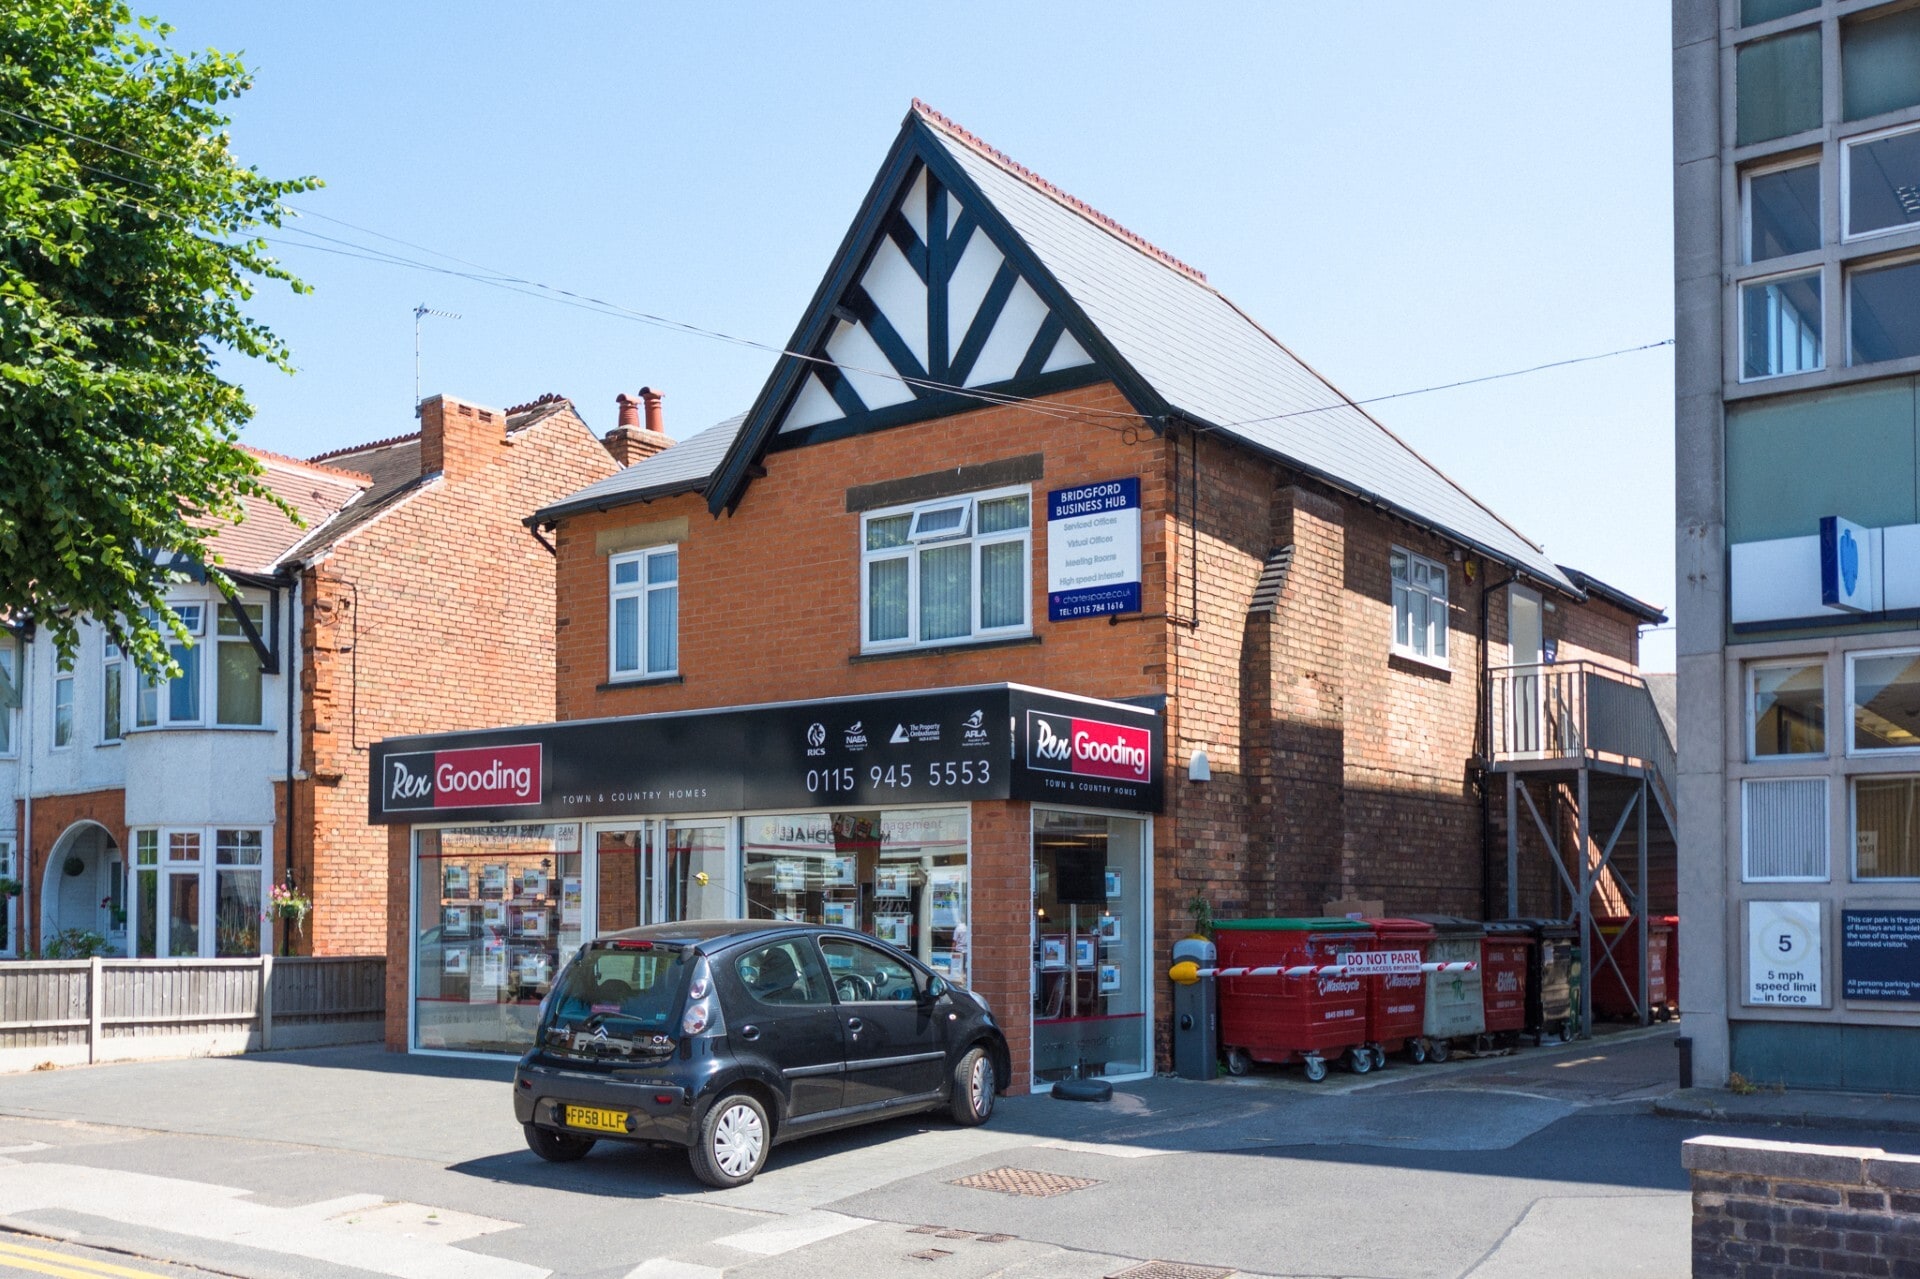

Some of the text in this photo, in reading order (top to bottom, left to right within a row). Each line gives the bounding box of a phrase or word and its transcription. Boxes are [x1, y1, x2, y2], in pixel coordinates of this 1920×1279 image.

[1061, 483, 1121, 503] BRIDGFORD
[1056, 495, 1126, 516] BUSINESS HUB
[1063, 516, 1117, 532] Serviced Offices
[1089, 535, 1113, 546] Offices
[1065, 553, 1117, 568] Meeting Rooms
[1073, 605, 1090, 615] 0115
[845, 735, 867, 744] NAEA
[964, 730, 987, 738] ARLA
[807, 748, 826, 756] RICS
[1036, 719, 1072, 760] Rex
[1074, 731, 1145, 775] Gooding
[391, 759, 531, 799] Rex Gooding
[806, 760, 990, 792] 0115 945 5553
[1045, 778, 1137, 796] TOWN & COUNTRY HOMES
[562, 788, 708, 805] TOWN & COUNTRY HOMES
[1847, 915, 1861, 923] This
[1874, 916, 1889, 924] park
[1855, 924, 1881, 932] Barclays
[1778, 934, 1792, 952] 5
[1347, 952, 1419, 966] DO NOT PARK
[1768, 970, 1804, 982] 5 mph
[1755, 982, 1817, 993] speed limit
[1884, 980, 1911, 988] parking
[1765, 992, 1807, 1003] in force
[571, 1108, 623, 1129] FP58 LLF
